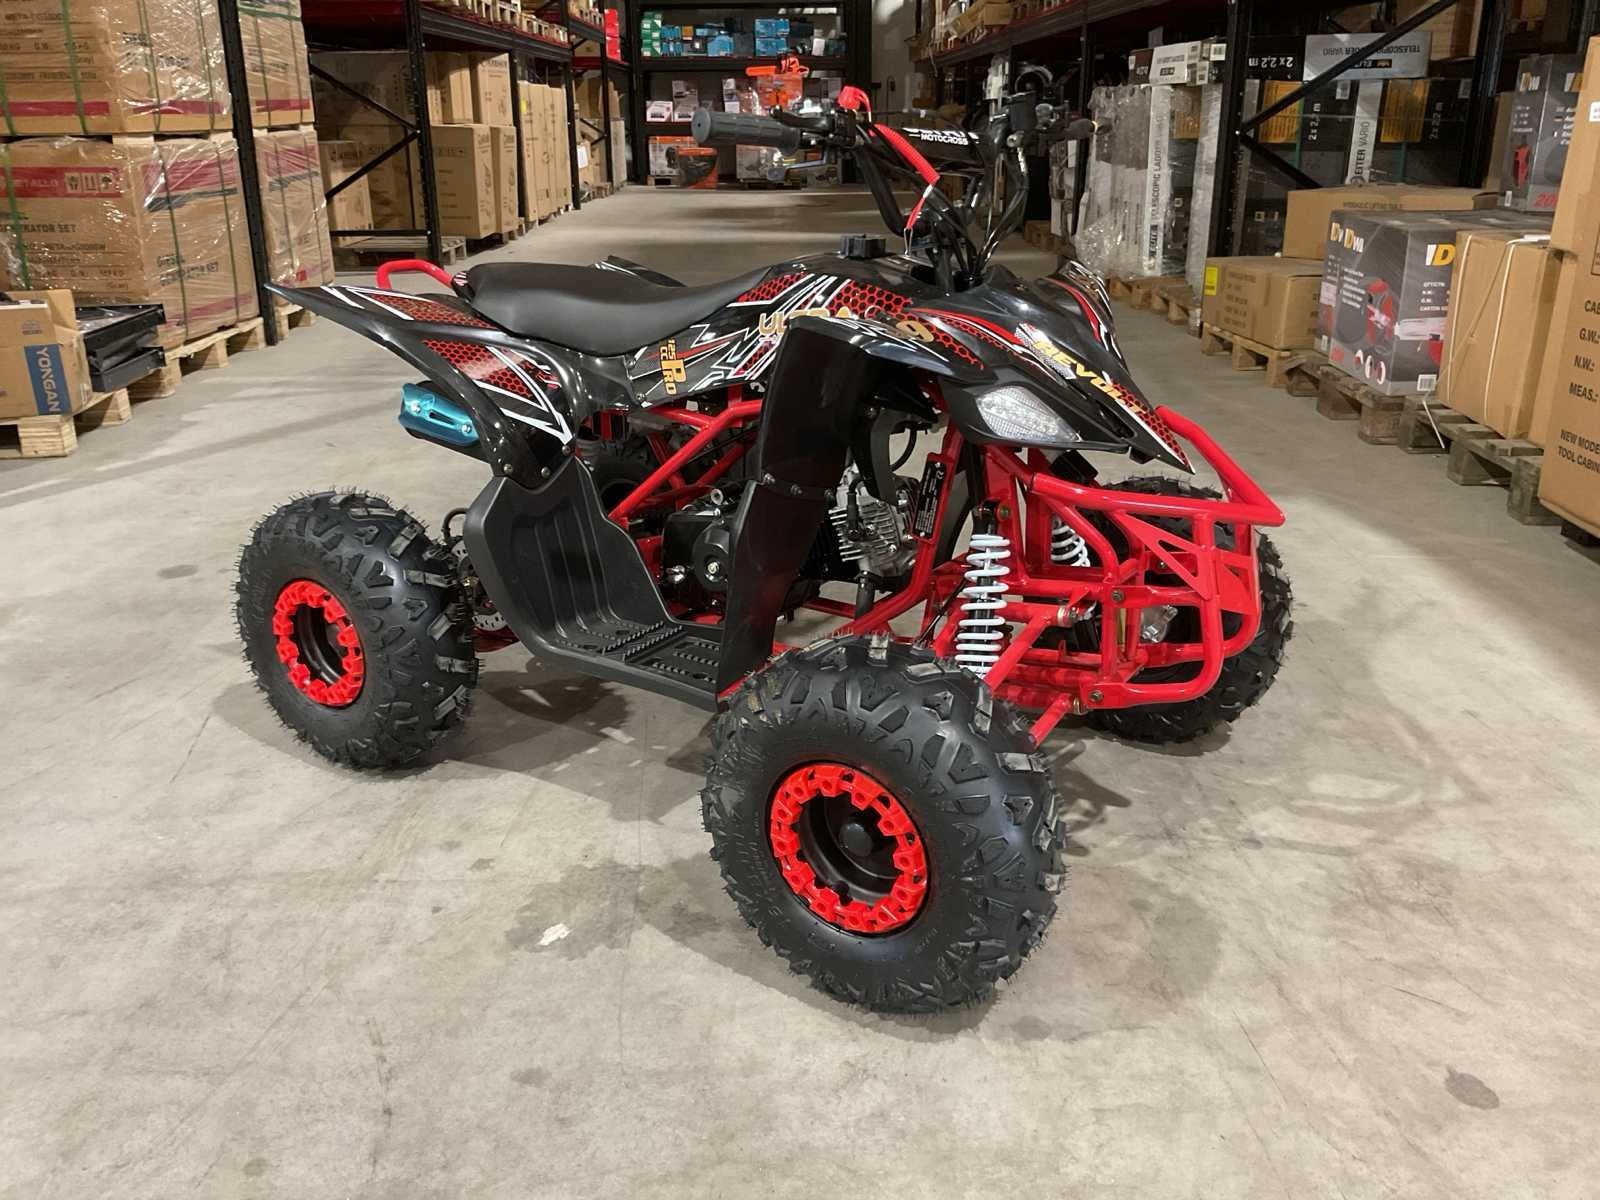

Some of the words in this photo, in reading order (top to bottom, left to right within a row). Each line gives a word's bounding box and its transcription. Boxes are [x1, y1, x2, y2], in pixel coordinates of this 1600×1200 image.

[1248, 57, 1259, 67] m
[1261, 56, 1277, 68] 2,2
[920, 133, 969, 145] MOTOCROSS
[57, 223, 76, 233] SET
[36, 346, 62, 412] YONGAN
[1033, 341, 1147, 414] REVOLT
[1561, 428, 1578, 445] NEW
[1558, 445, 1575, 463] TOOL
